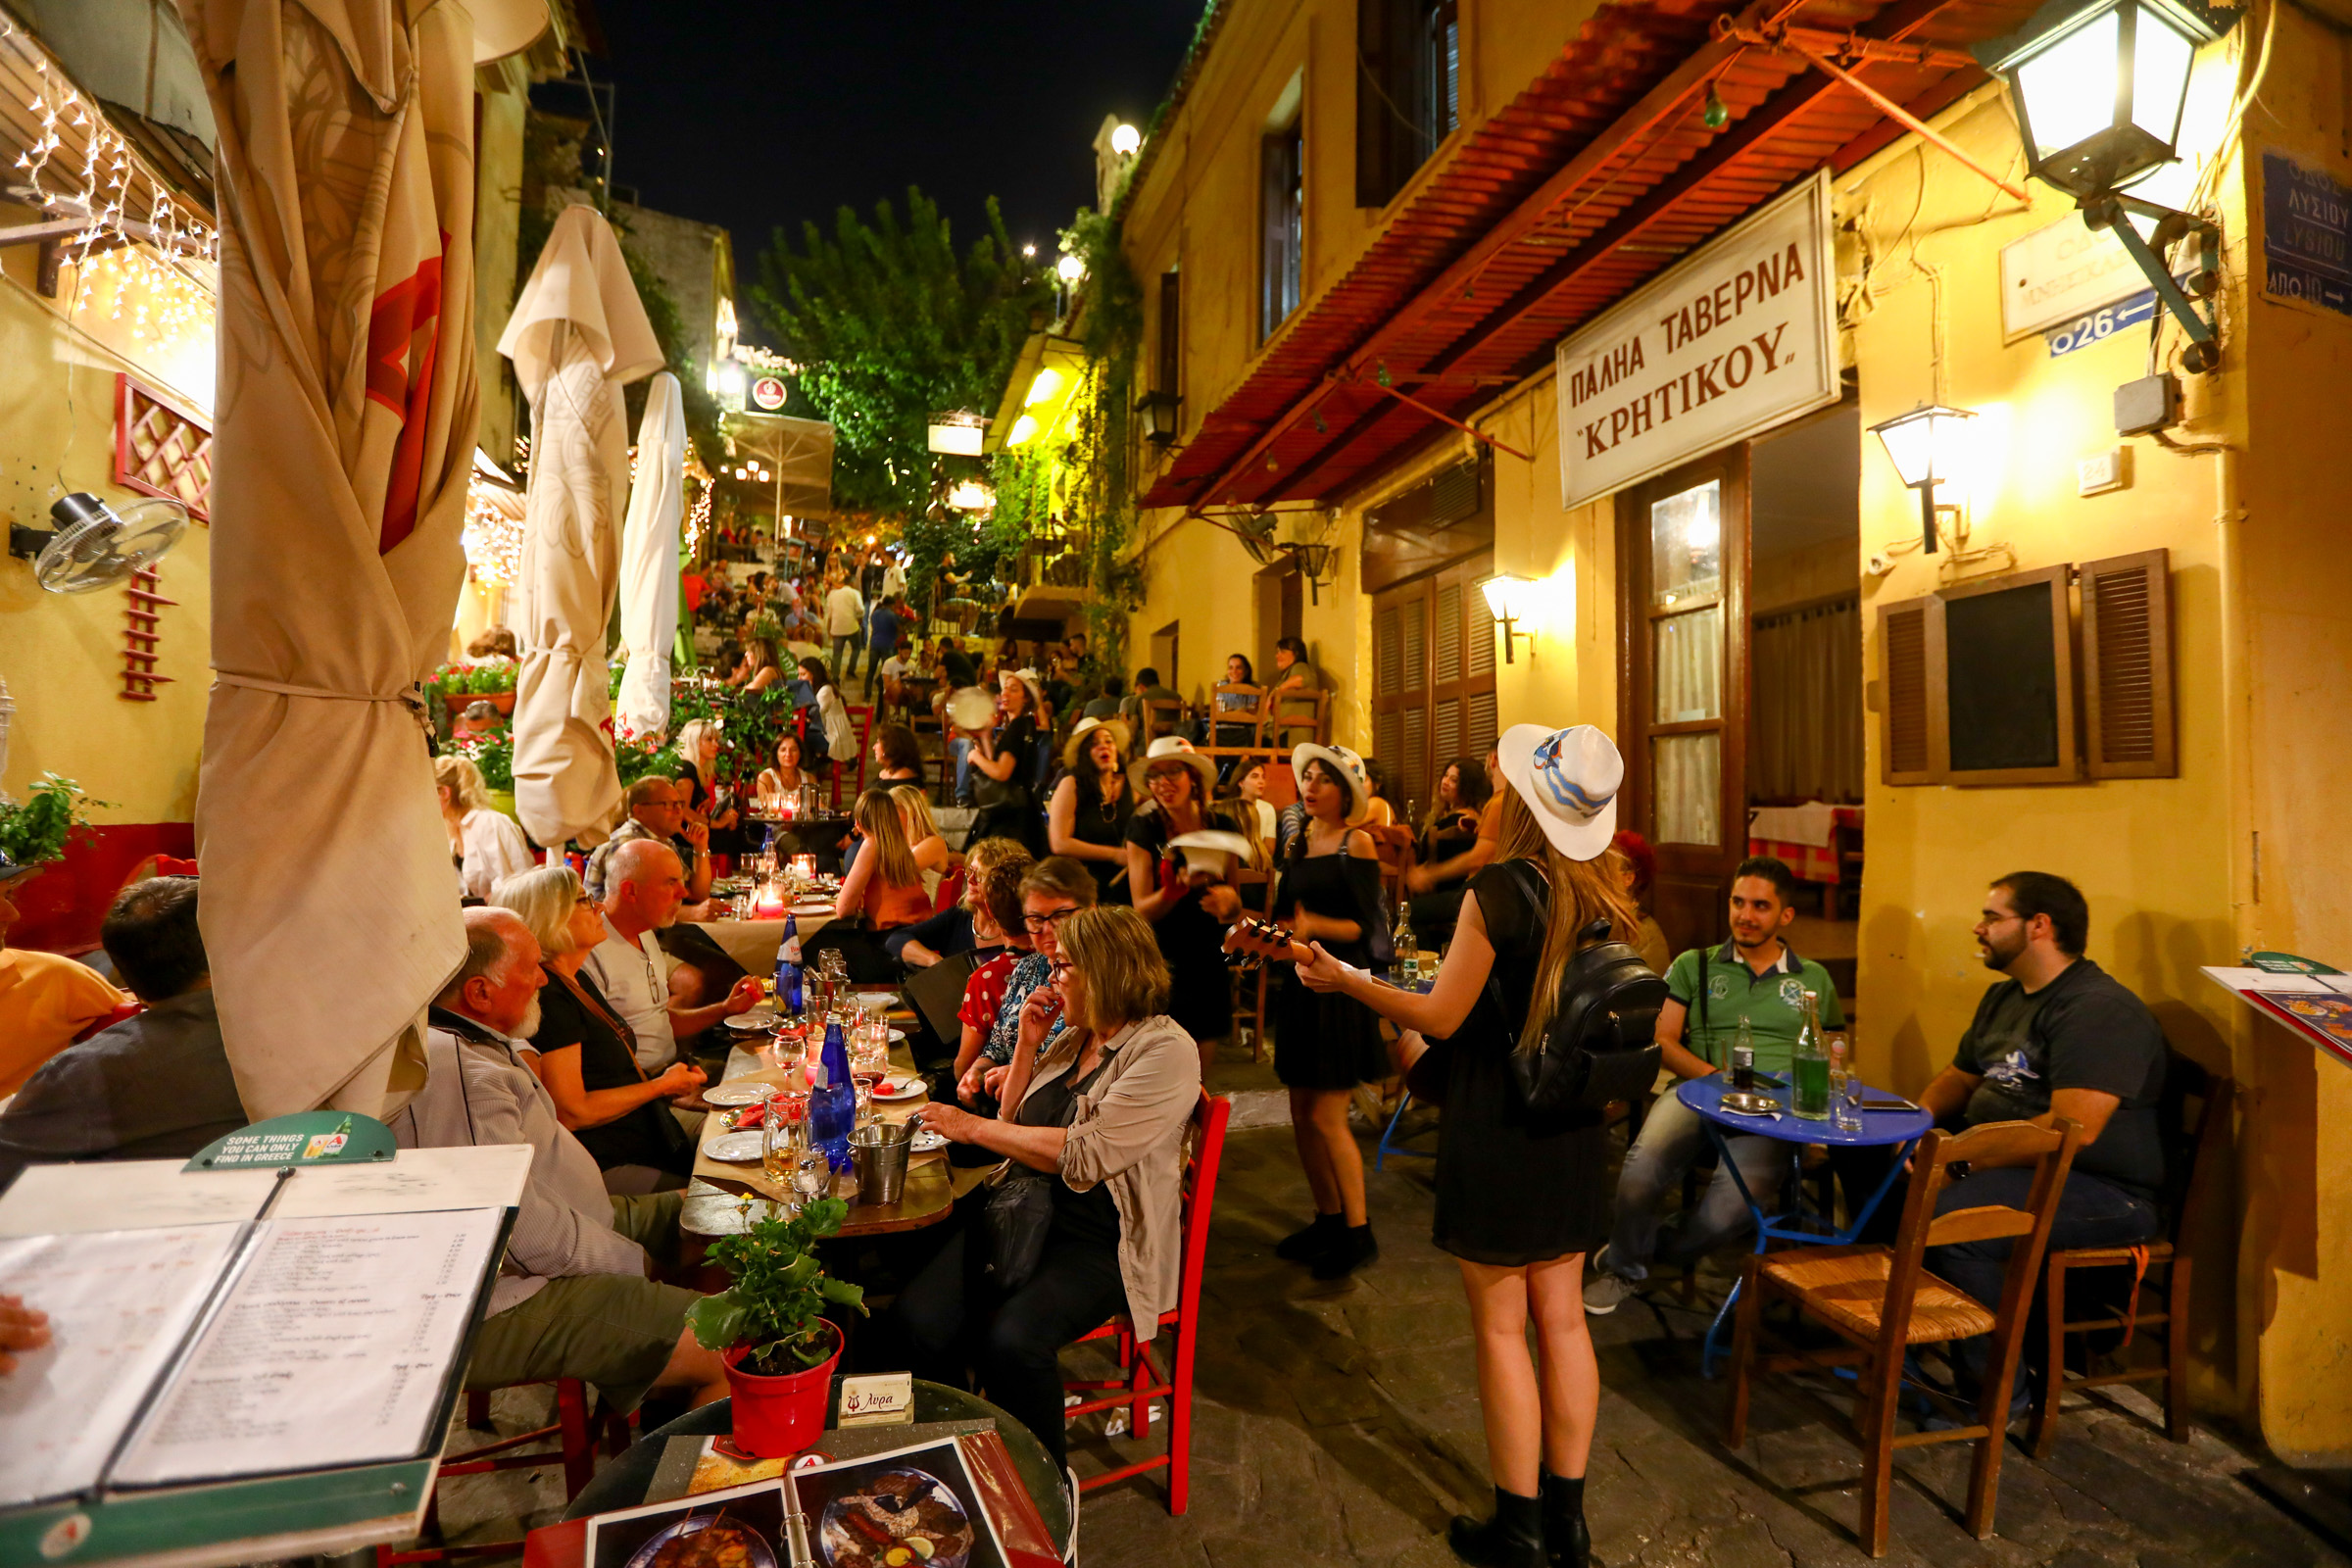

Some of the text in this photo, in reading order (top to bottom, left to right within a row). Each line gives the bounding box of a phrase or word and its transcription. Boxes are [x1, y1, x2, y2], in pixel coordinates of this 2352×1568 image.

[2288, 187, 2350, 228] ΛΥΣΙΟΥ
[1571, 242, 1805, 409] ΠΑΛΗΑ ΤΑΒΕΡΝΑ
[226, 1134, 305, 1145] SOME THINGS
[221, 1143, 299, 1154] YOU CAN ONLY
[214, 1152, 294, 1164] FIND IN GREECE
